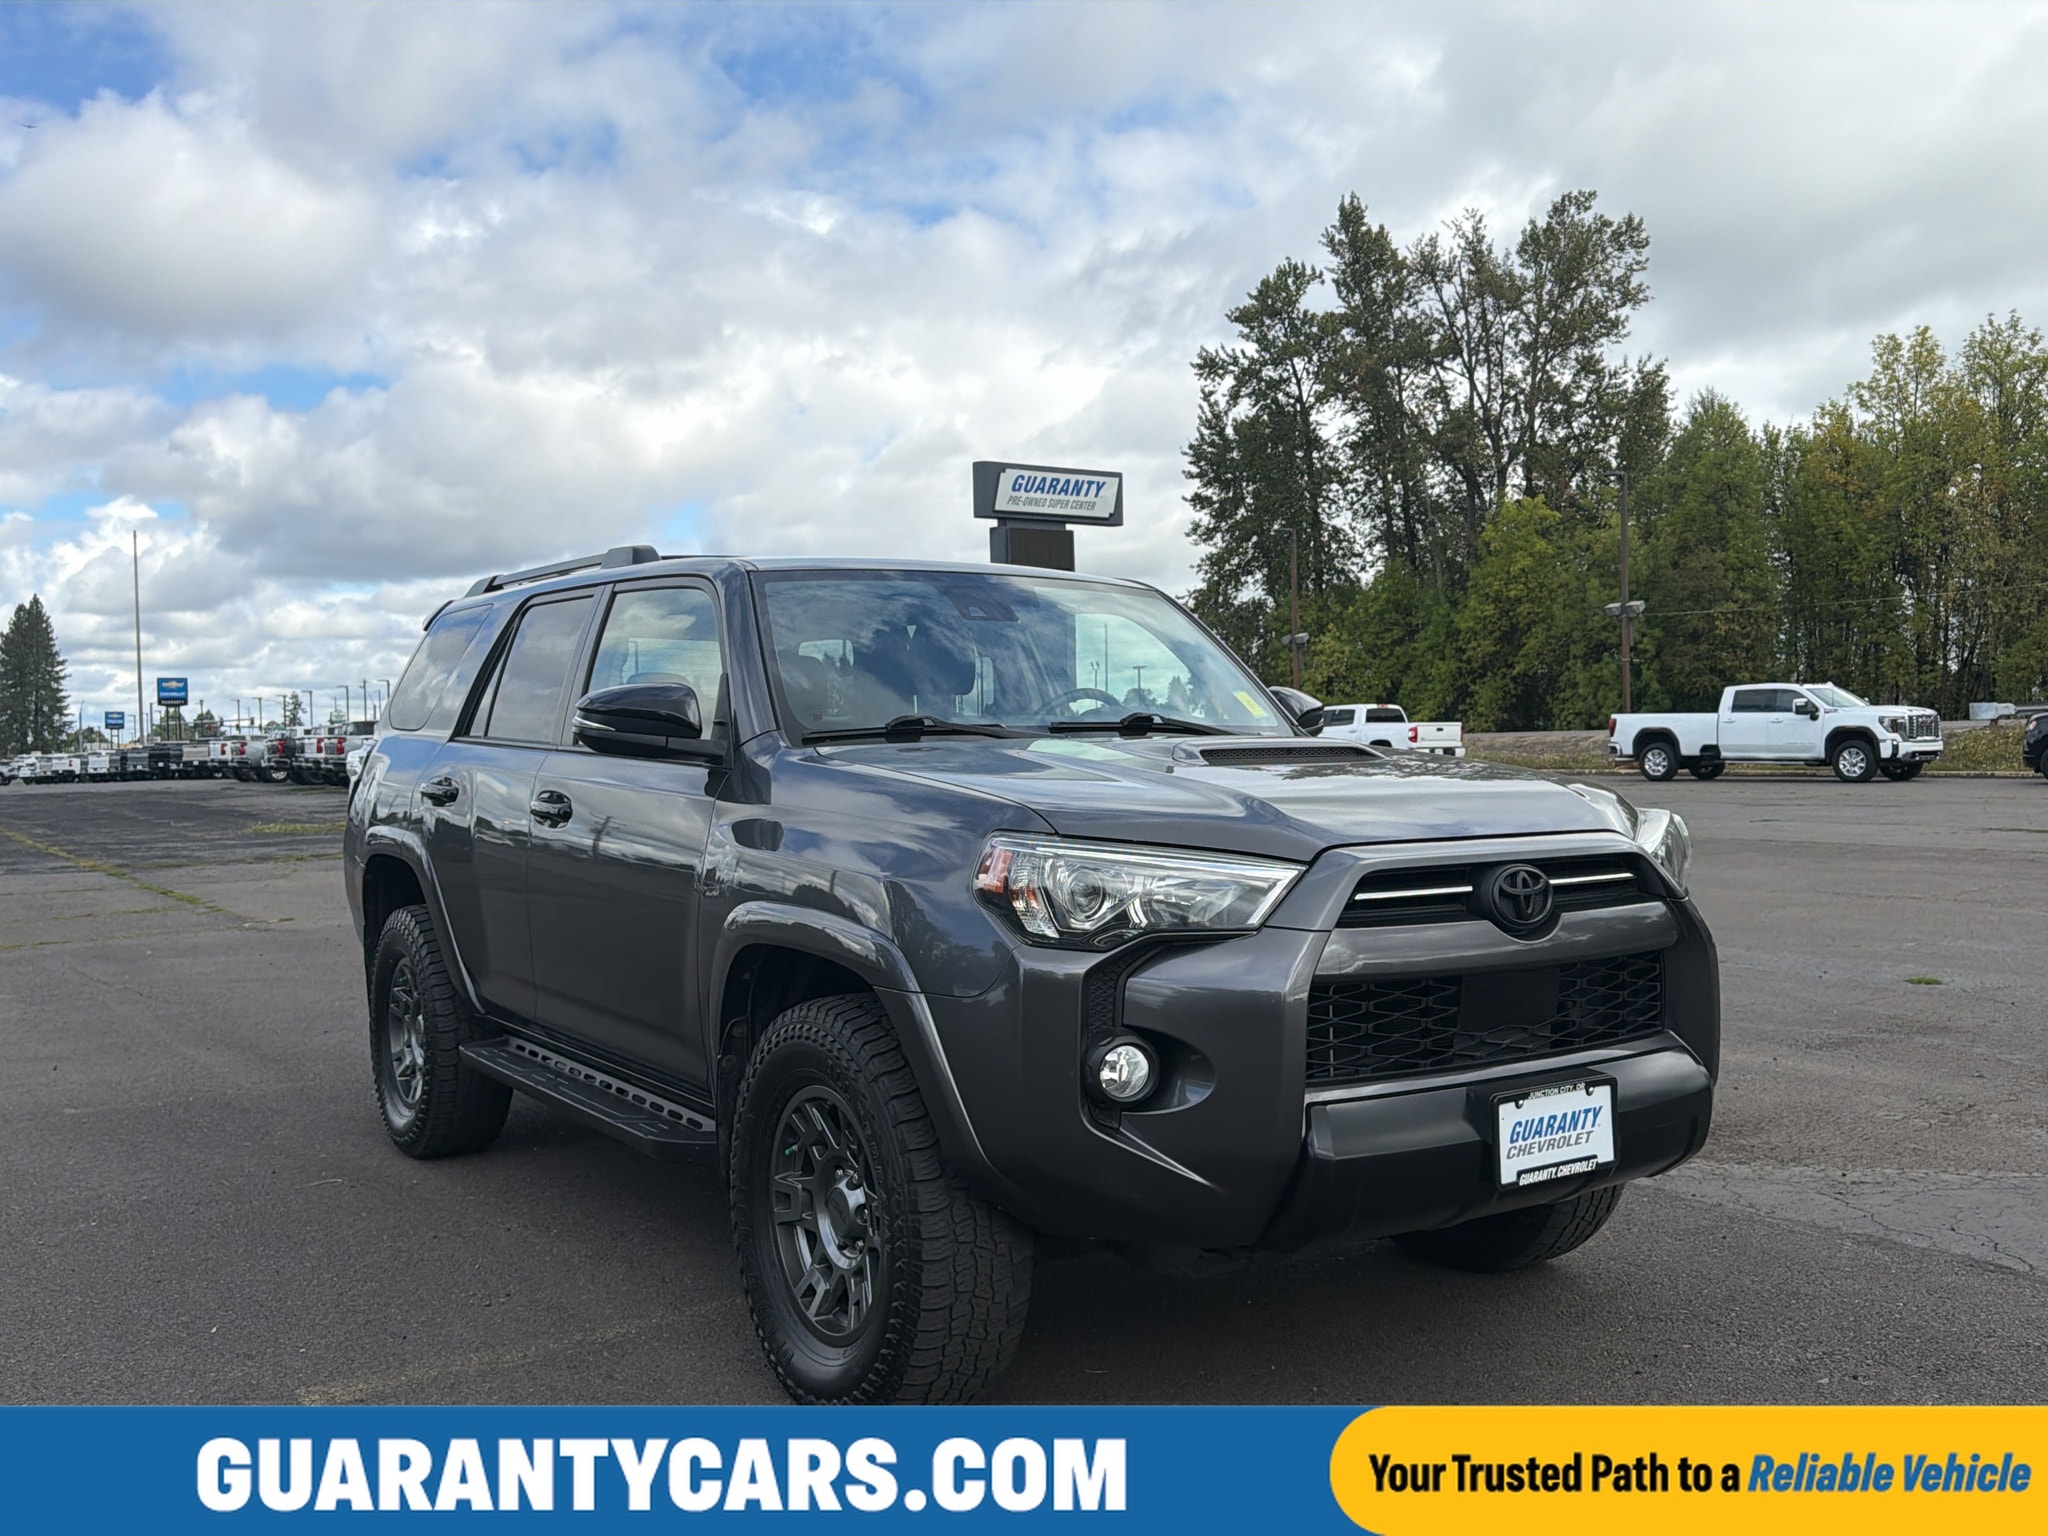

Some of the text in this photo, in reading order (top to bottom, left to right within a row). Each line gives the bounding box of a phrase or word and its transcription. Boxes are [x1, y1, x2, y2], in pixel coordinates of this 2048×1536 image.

[1011, 474, 1106, 498] GUARANTY
[1006, 495, 1097, 511] PRE-OWNED SUPER CENTER
[1528, 1087, 1559, 1100] JUNCTION
[1509, 1105, 1603, 1145] GUARANTY
[1506, 1130, 1595, 1160] CHEVROLET
[1557, 1158, 1598, 1178] CHEVROLET
